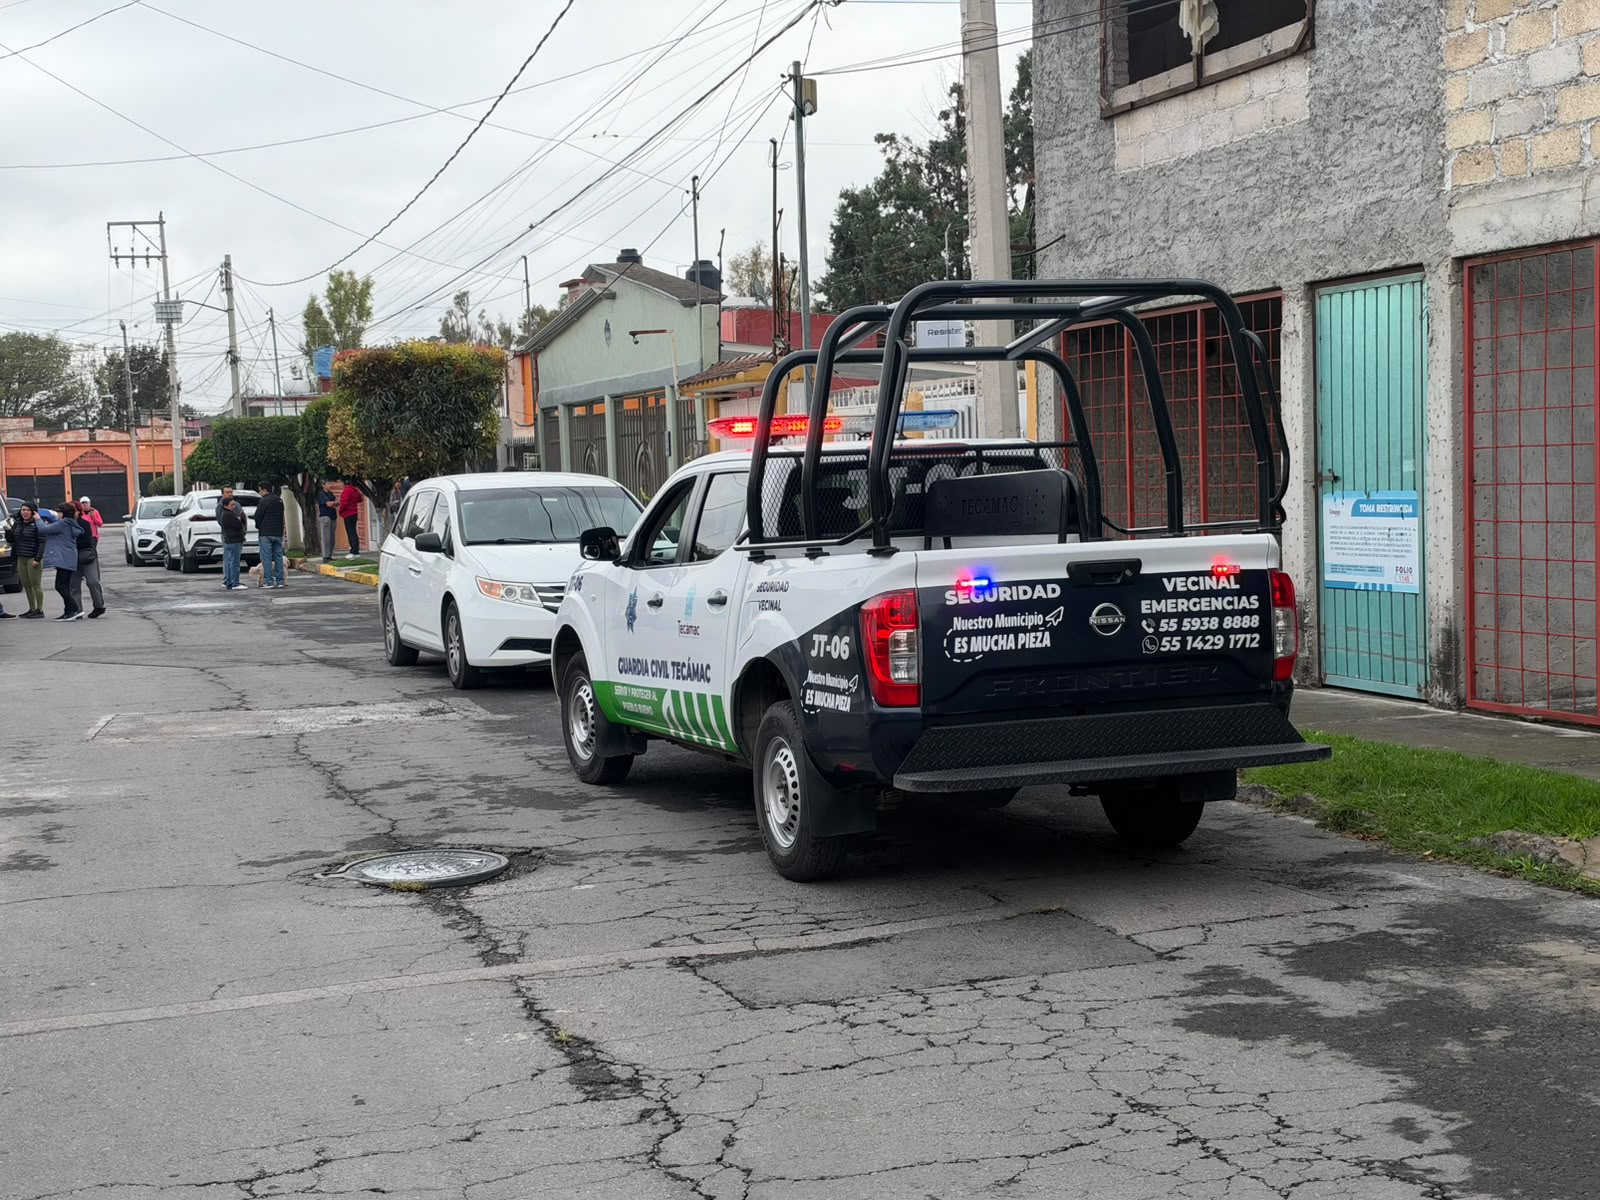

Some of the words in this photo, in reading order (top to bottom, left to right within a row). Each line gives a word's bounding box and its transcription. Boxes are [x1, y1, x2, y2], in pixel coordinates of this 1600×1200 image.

[1395, 566, 1413, 574] FOLIO
[755, 581, 790, 593] SEGURIDAD
[1162, 575, 1241, 592] VECINAL
[944, 583, 1062, 606] SEGURIDAD
[758, 599, 782, 611] VECINAL
[1140, 596, 1259, 614] EMERGENCIAS
[953, 616, 993, 631] Nuestro
[994, 612, 1044, 630] Municipio
[1089, 616, 1126, 625] NISSAN
[1158, 618, 1178, 632] 55
[1181, 617, 1219, 631] 5938
[1222, 615, 1260, 629] 8888
[810, 633, 851, 660] JT-06
[954, 636, 968, 654] ES
[969, 633, 1015, 653] MUCHA
[1017, 631, 1051, 649] PIEZA
[1160, 636, 1181, 651] 55
[1186, 635, 1224, 651] 1429
[1228, 633, 1261, 649] 1712
[618, 657, 649, 677] GUARDIA
[650, 659, 670, 679] CIVIL
[671, 656, 711, 684] TECÁMAC
[807, 669, 826, 685] Nuestro
[826, 672, 849, 692] Municipio
[805, 689, 815, 705] ES
[814, 690, 835, 709] MUCHA
[835, 694, 851, 712] PIEZA
